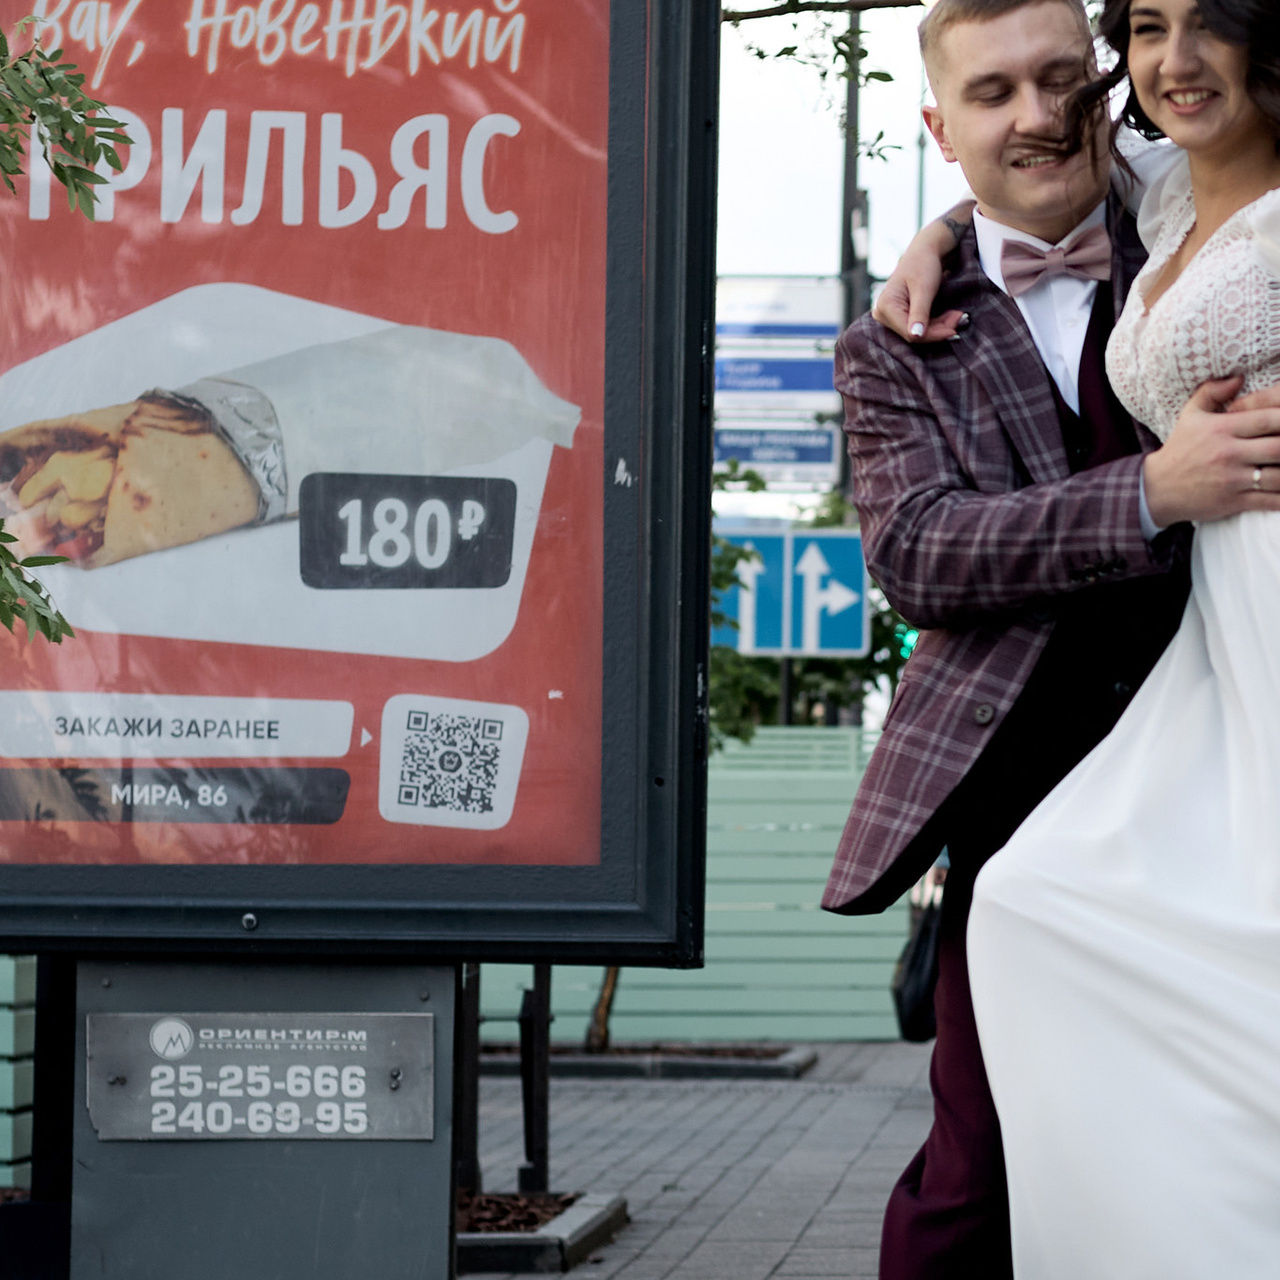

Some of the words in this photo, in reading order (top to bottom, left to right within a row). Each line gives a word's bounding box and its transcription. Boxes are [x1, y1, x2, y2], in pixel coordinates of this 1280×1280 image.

[54, 716, 163, 739] ЗАКАЖИ
[170, 719, 280, 740] ЗАРАНЕЕ
[110, 783, 191, 810] МИРА,
[196, 784, 229, 807] 86
[150, 1064, 367, 1099] 25-25-666
[151, 1100, 369, 1134] 240-69-95
